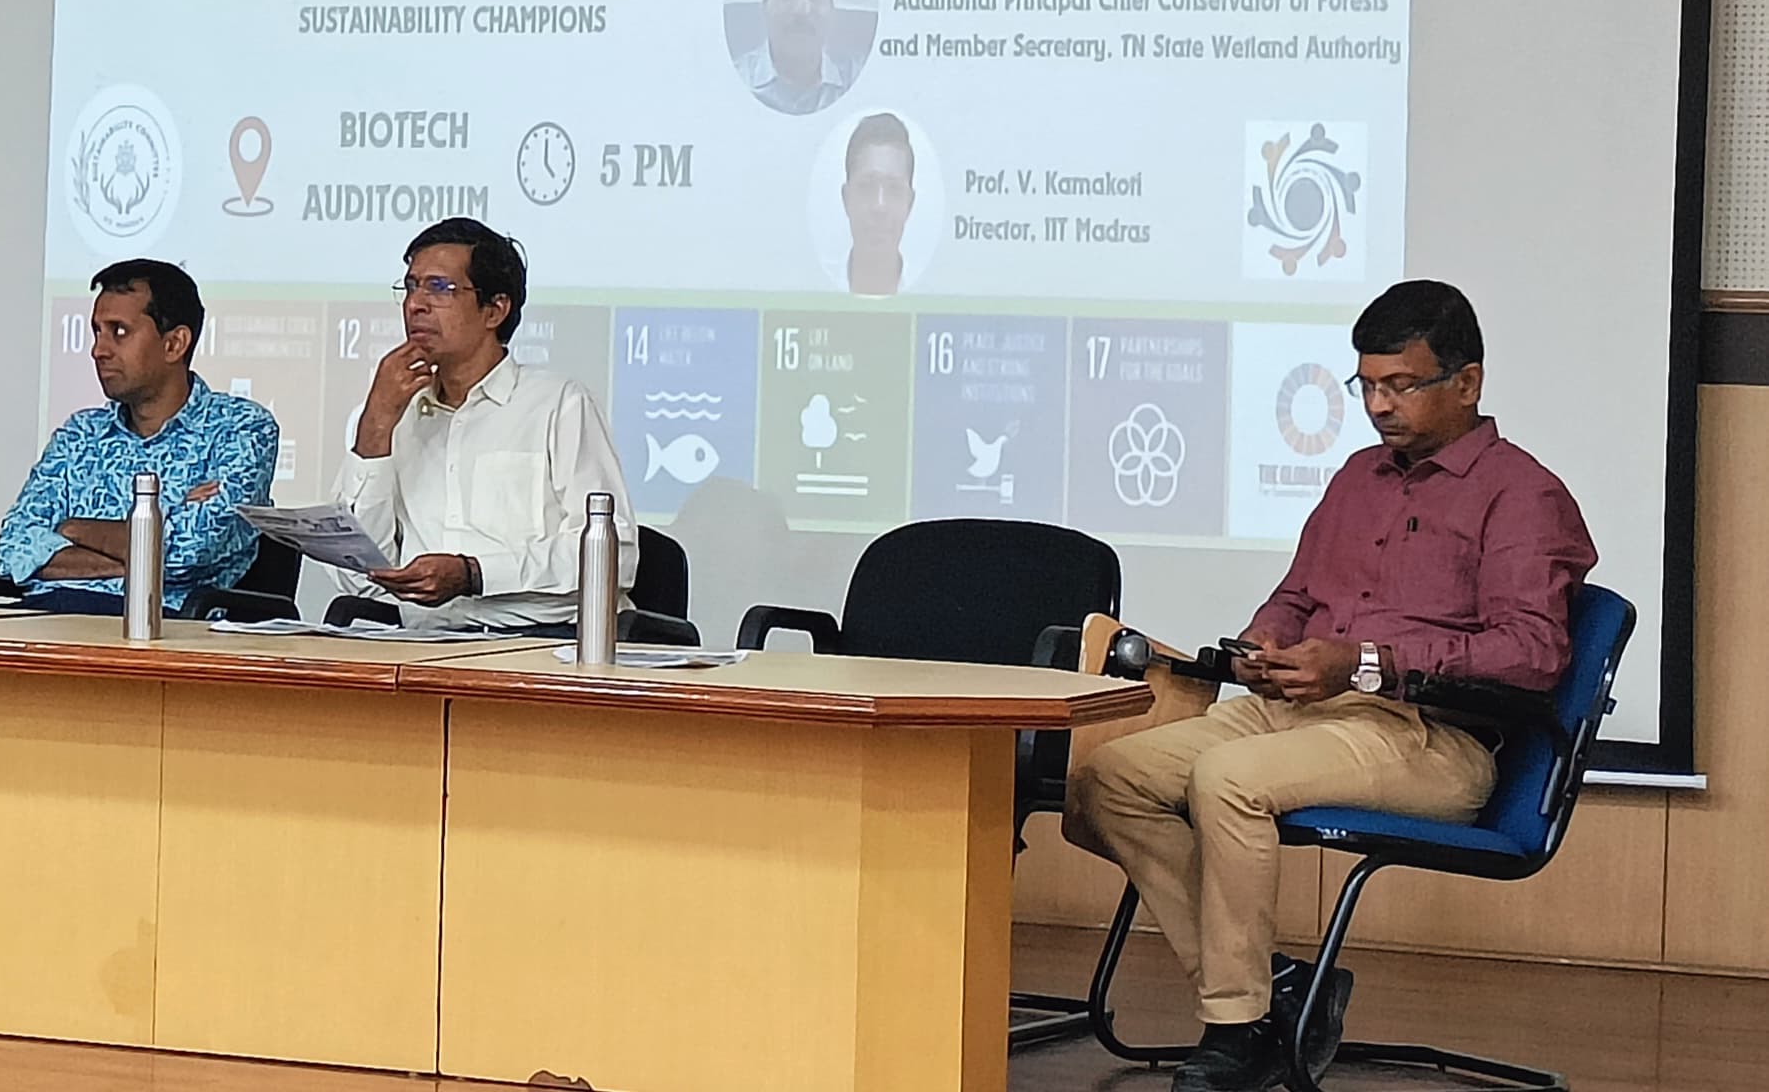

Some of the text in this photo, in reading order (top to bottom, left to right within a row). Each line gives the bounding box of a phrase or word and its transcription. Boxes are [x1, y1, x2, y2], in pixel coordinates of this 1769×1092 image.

[298, 4, 606, 34] SUSTAINABILITY CHAMPIONS
[879, 33, 918, 57] and
[926, 33, 1007, 57] Member
[1121, 34, 1145, 58] TN
[1152, 34, 1204, 58] State
[1211, 35, 1299, 59] Wetland
[1305, 35, 1402, 64] Authority
[339, 110, 469, 148] BIOTECH
[599, 144, 694, 187] 5 PM
[966, 169, 1008, 194] Prof.
[1017, 169, 1036, 194] V.
[301, 184, 489, 222] AUDITORIUM
[1045, 217, 1068, 242] IIT
[1076, 217, 1150, 243] Madras
[61, 313, 85, 354] 10
[337, 318, 361, 359] 12
[626, 325, 649, 365] 14
[773, 327, 799, 370] 15
[927, 332, 954, 374] 16
[1087, 336, 1111, 380] 17
